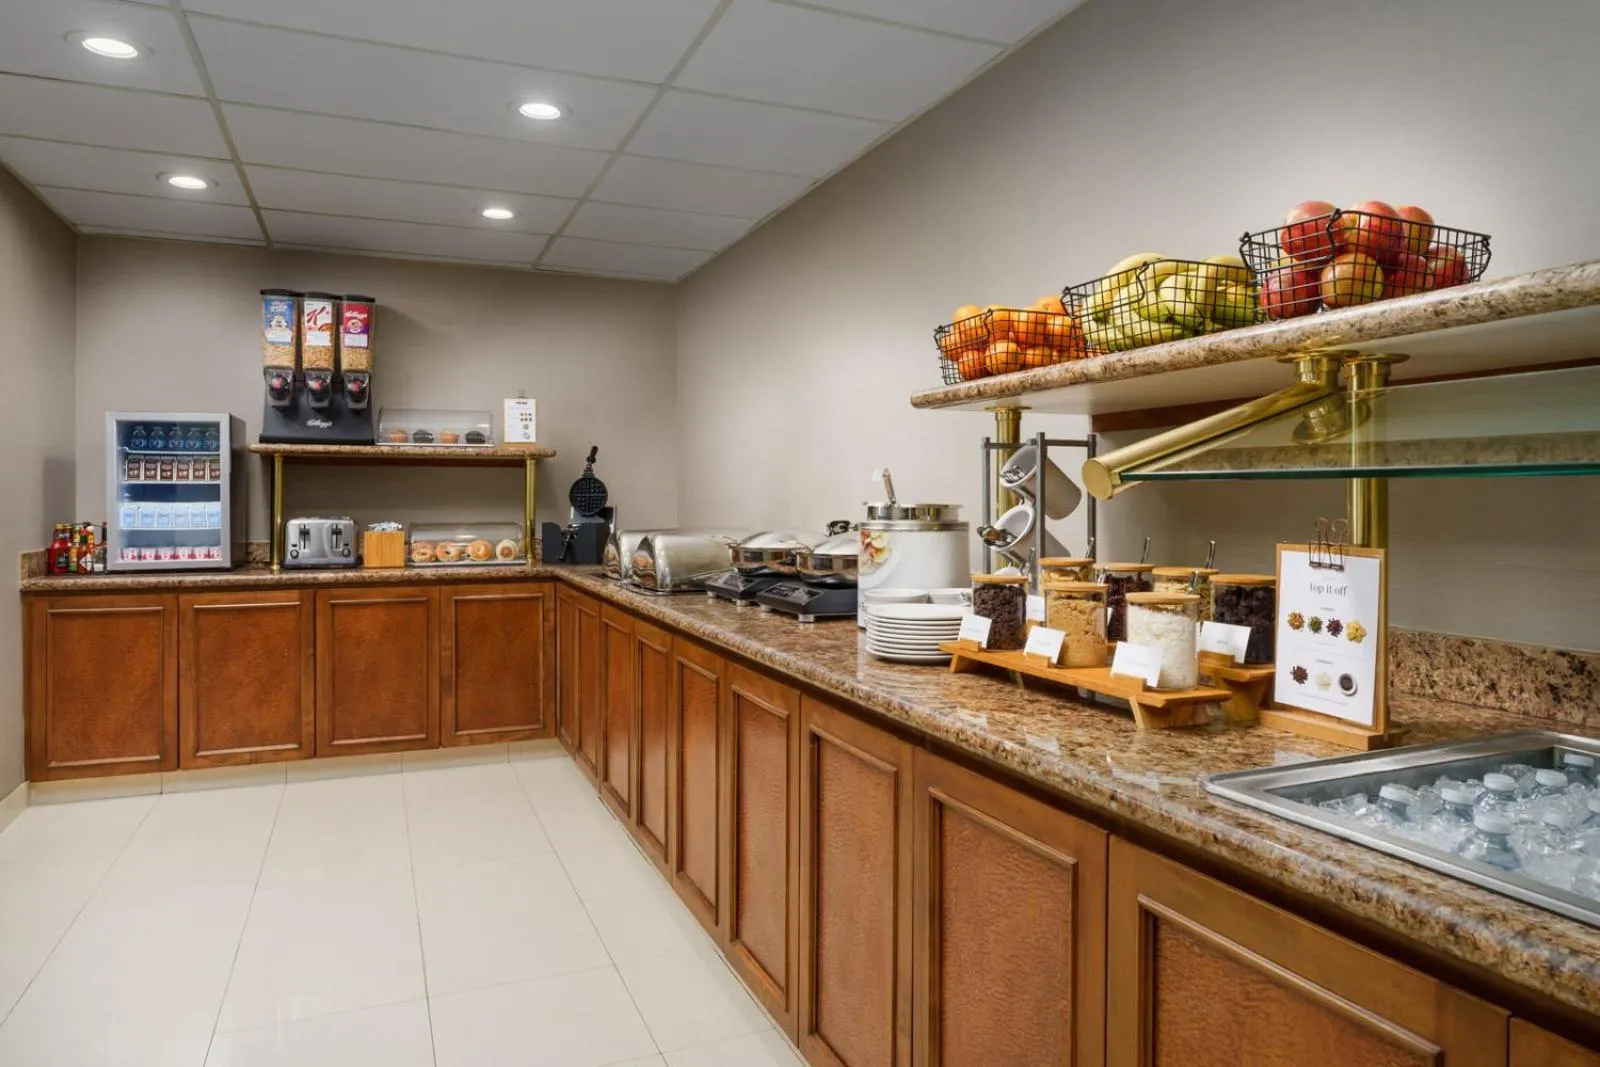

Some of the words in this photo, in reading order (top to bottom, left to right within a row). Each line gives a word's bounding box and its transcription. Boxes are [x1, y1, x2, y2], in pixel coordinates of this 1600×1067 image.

[1310, 581, 1324, 594] top
[1326, 583, 1332, 593] it
[1334, 586, 1348, 596] off
